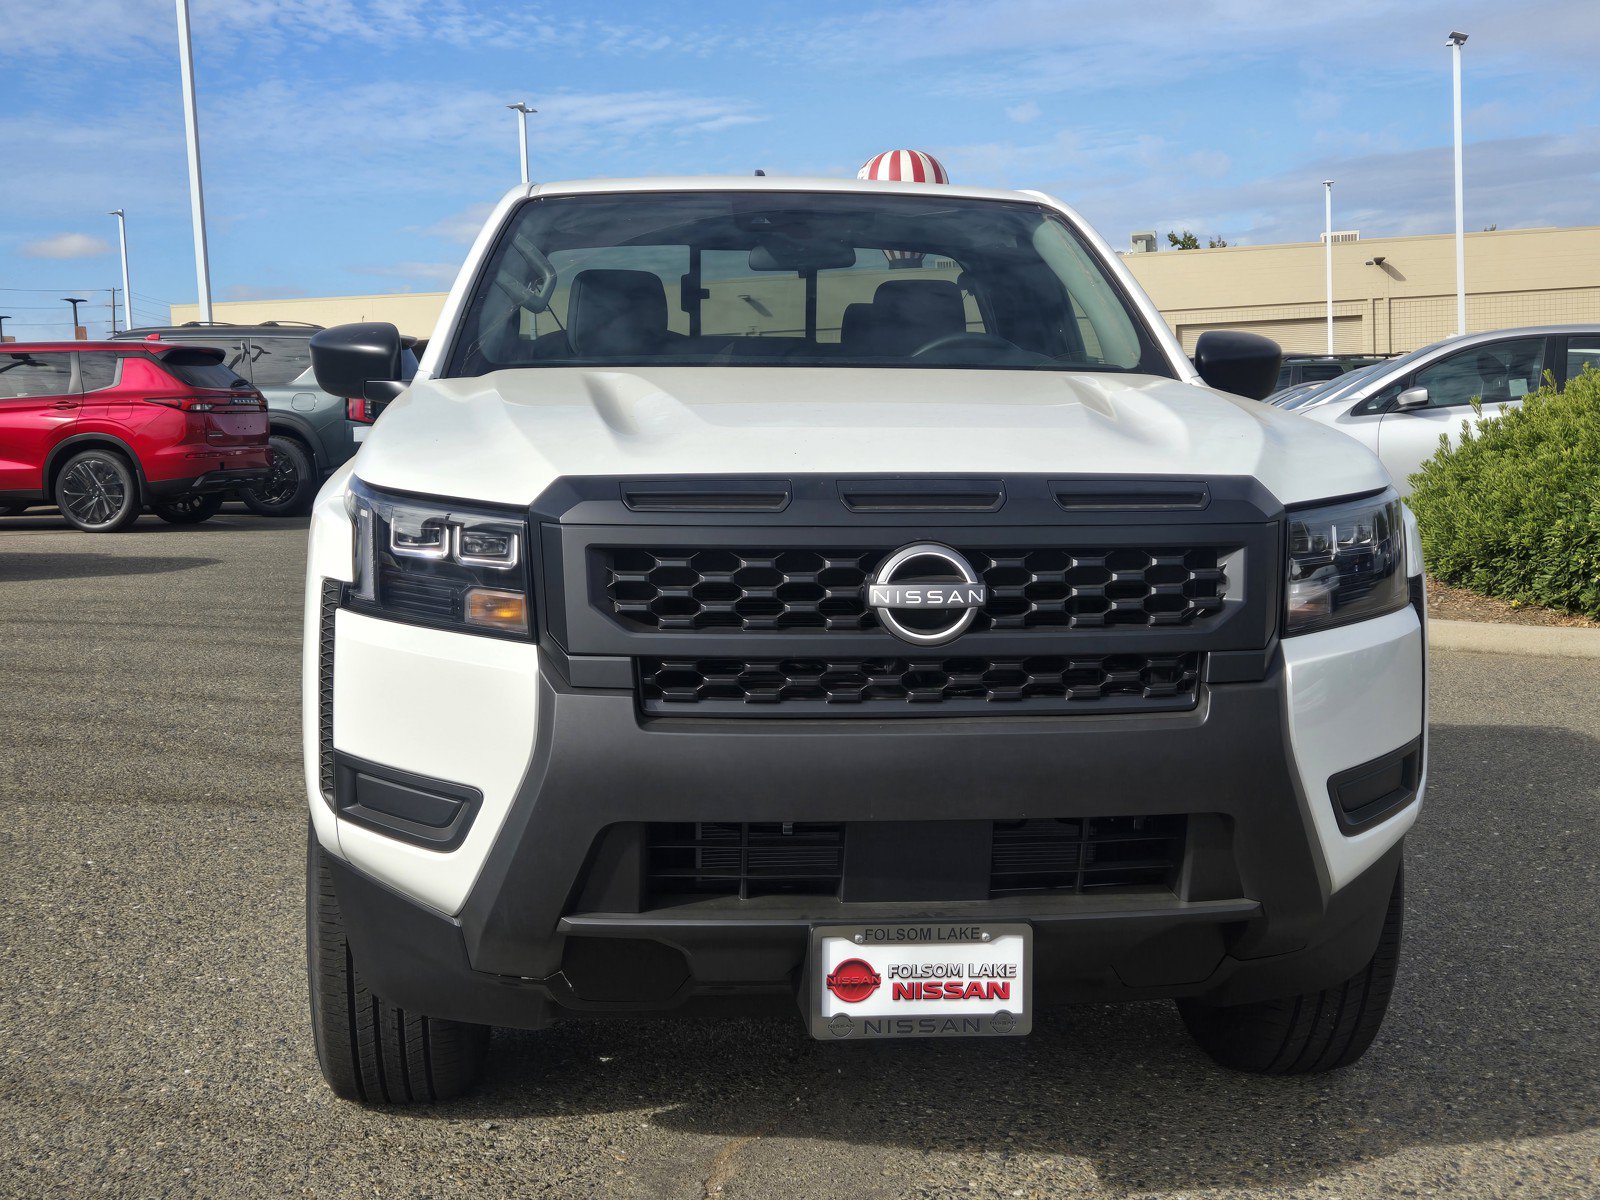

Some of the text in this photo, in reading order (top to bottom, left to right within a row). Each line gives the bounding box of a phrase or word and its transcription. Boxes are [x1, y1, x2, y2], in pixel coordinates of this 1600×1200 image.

[873, 589, 984, 604] NISSAN
[865, 927, 981, 941] FOLSOM LAKE
[888, 963, 1017, 979] FOLSOM LAKE
[826, 975, 881, 986] NISSAN
[892, 981, 1011, 1001] NISSAN
[863, 1018, 981, 1034] NISSAN
